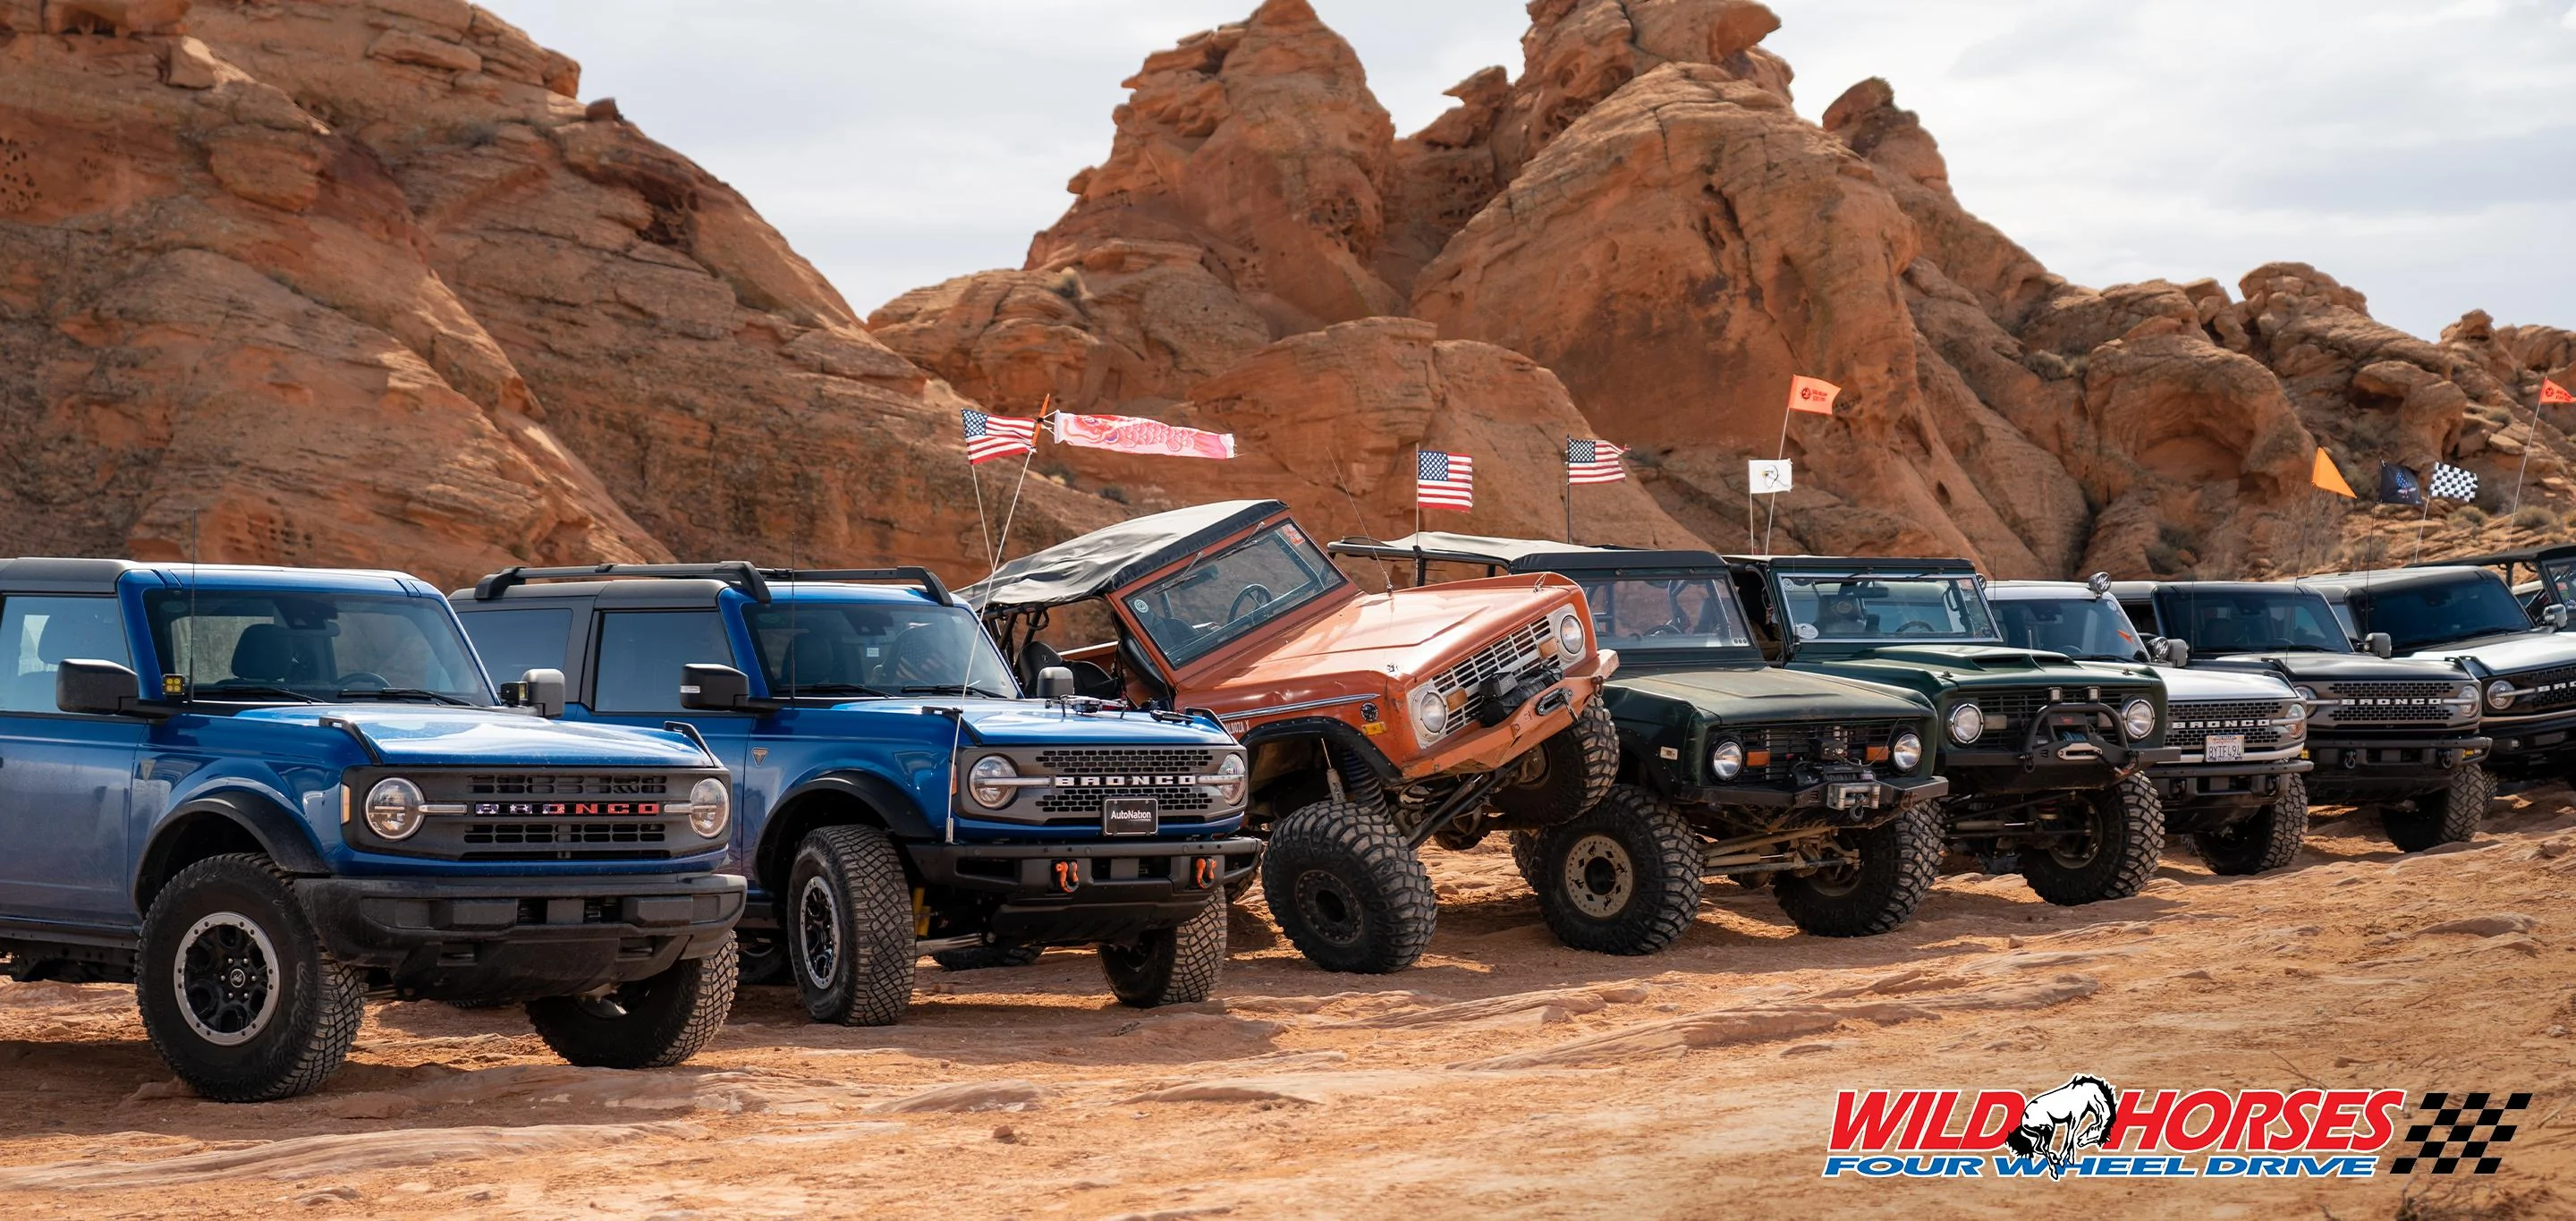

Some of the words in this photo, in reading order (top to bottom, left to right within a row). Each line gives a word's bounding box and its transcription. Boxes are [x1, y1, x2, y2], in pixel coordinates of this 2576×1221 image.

[2342, 698, 2442, 706] BRONCO
[2172, 719, 2269, 728] BRONCO
[1055, 776, 1196, 786] BRONCO
[475, 803, 659, 815] BRONCO
[1111, 810, 1152, 819] AutoNation
